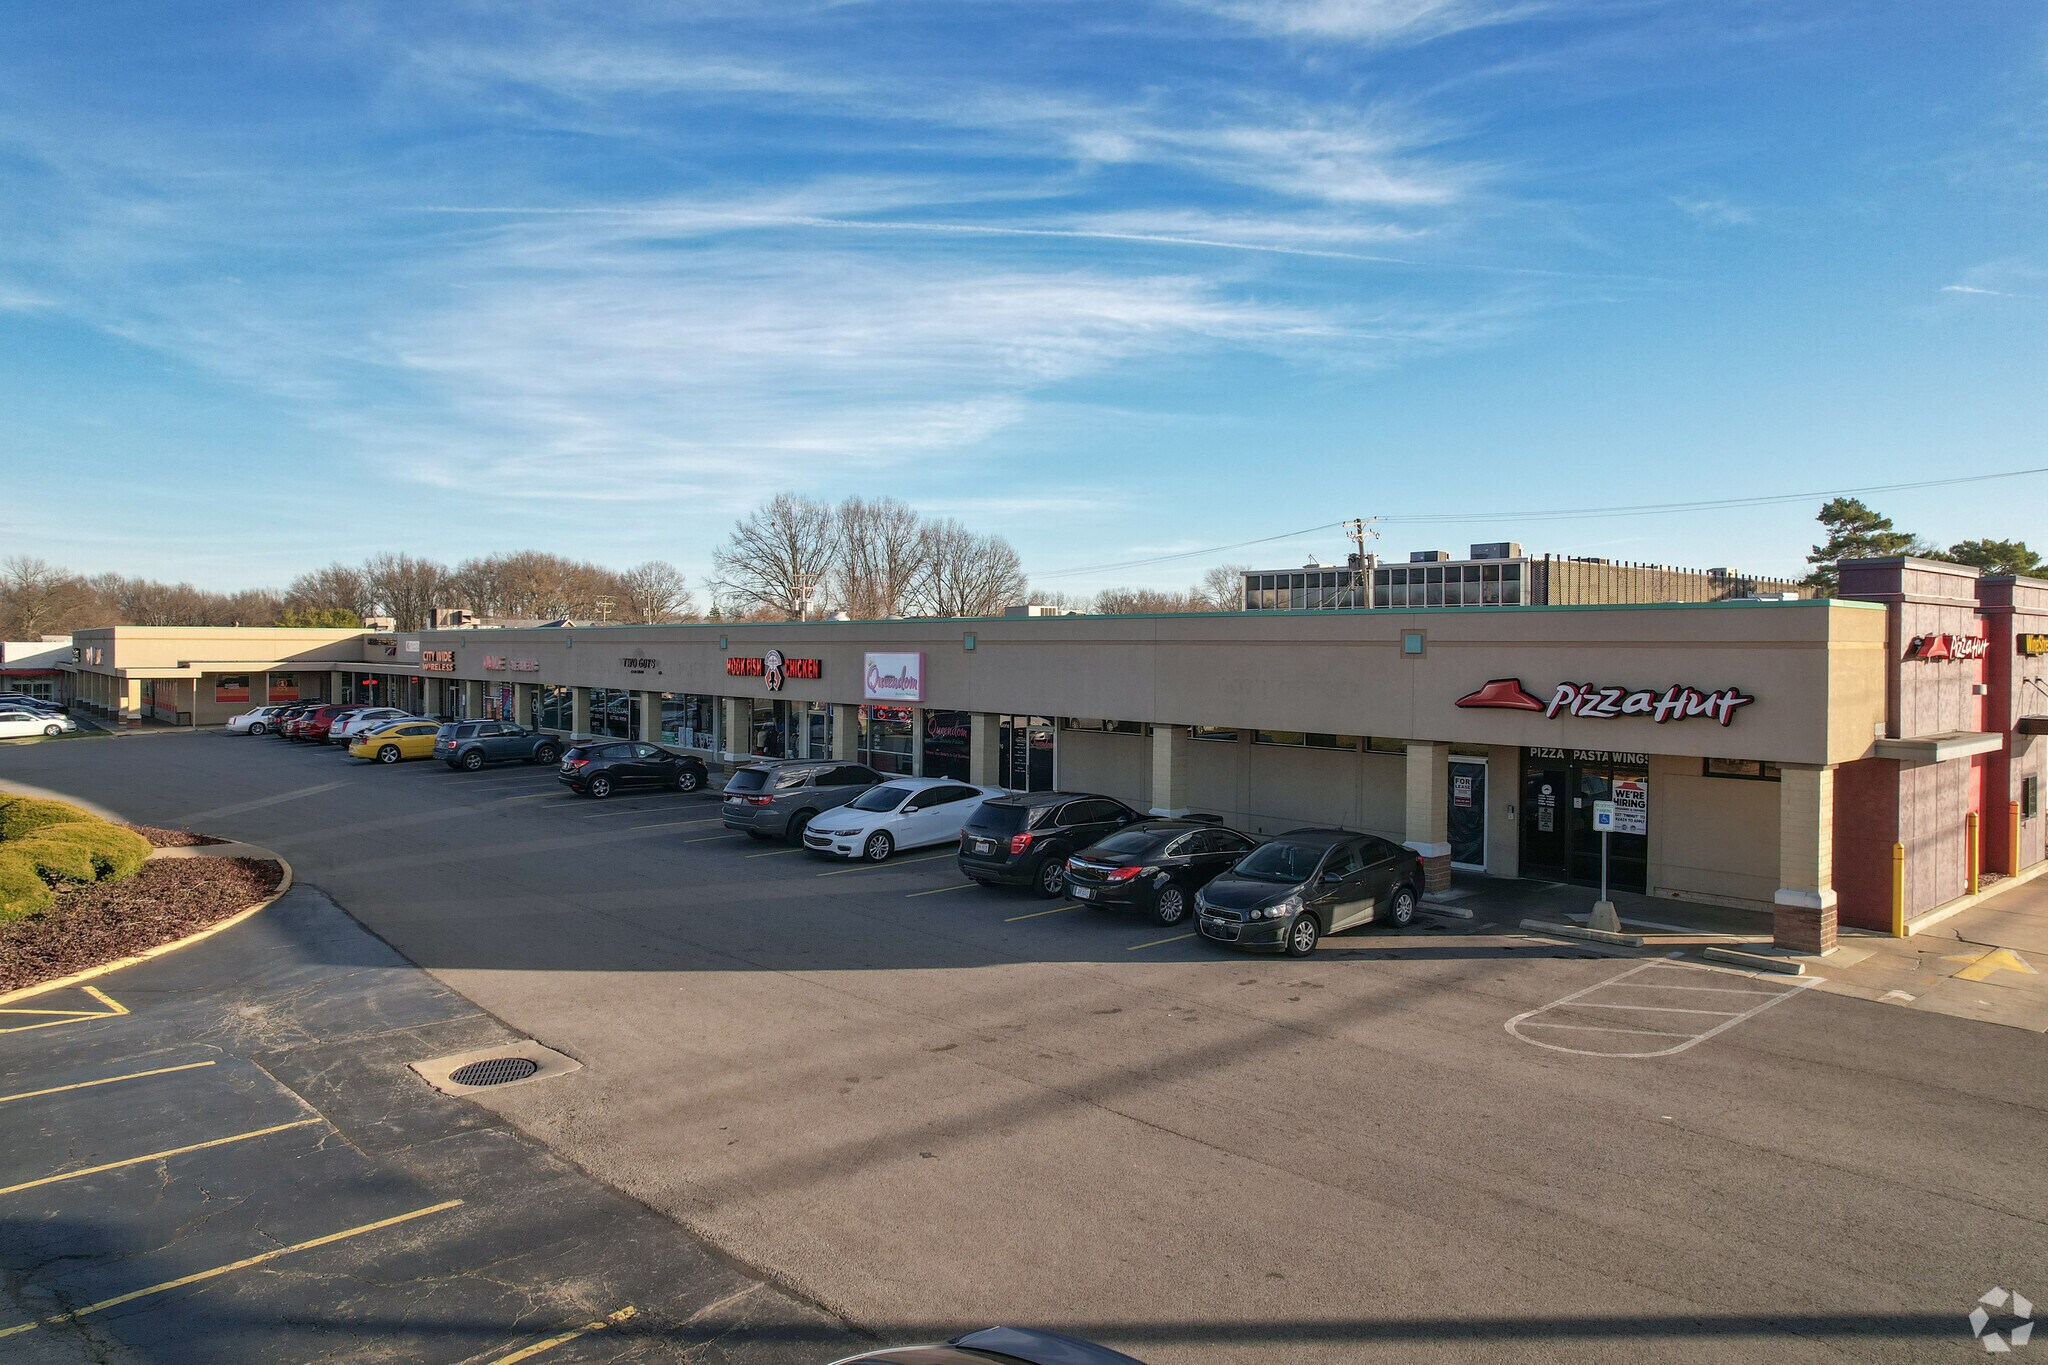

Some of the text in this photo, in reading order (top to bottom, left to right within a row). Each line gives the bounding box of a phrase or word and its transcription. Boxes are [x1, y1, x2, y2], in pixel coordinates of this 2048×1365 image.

[422, 651, 454, 662] CITY WIDE
[639, 658, 657, 669] GUYS
[422, 663, 454, 672] WIRELESS
[726, 657, 763, 677] HOOK FISH
[784, 658, 820, 679] CHICKEN
[867, 664, 918, 694] Queendom
[1546, 681, 1754, 727] Pizza Hut
[927, 716, 968, 738] Queendom
[1530, 747, 1648, 765] PIZZA PASTA WINGS
[1614, 798, 1646, 808] HIRING
[1615, 789, 1645, 800] WE'RE
